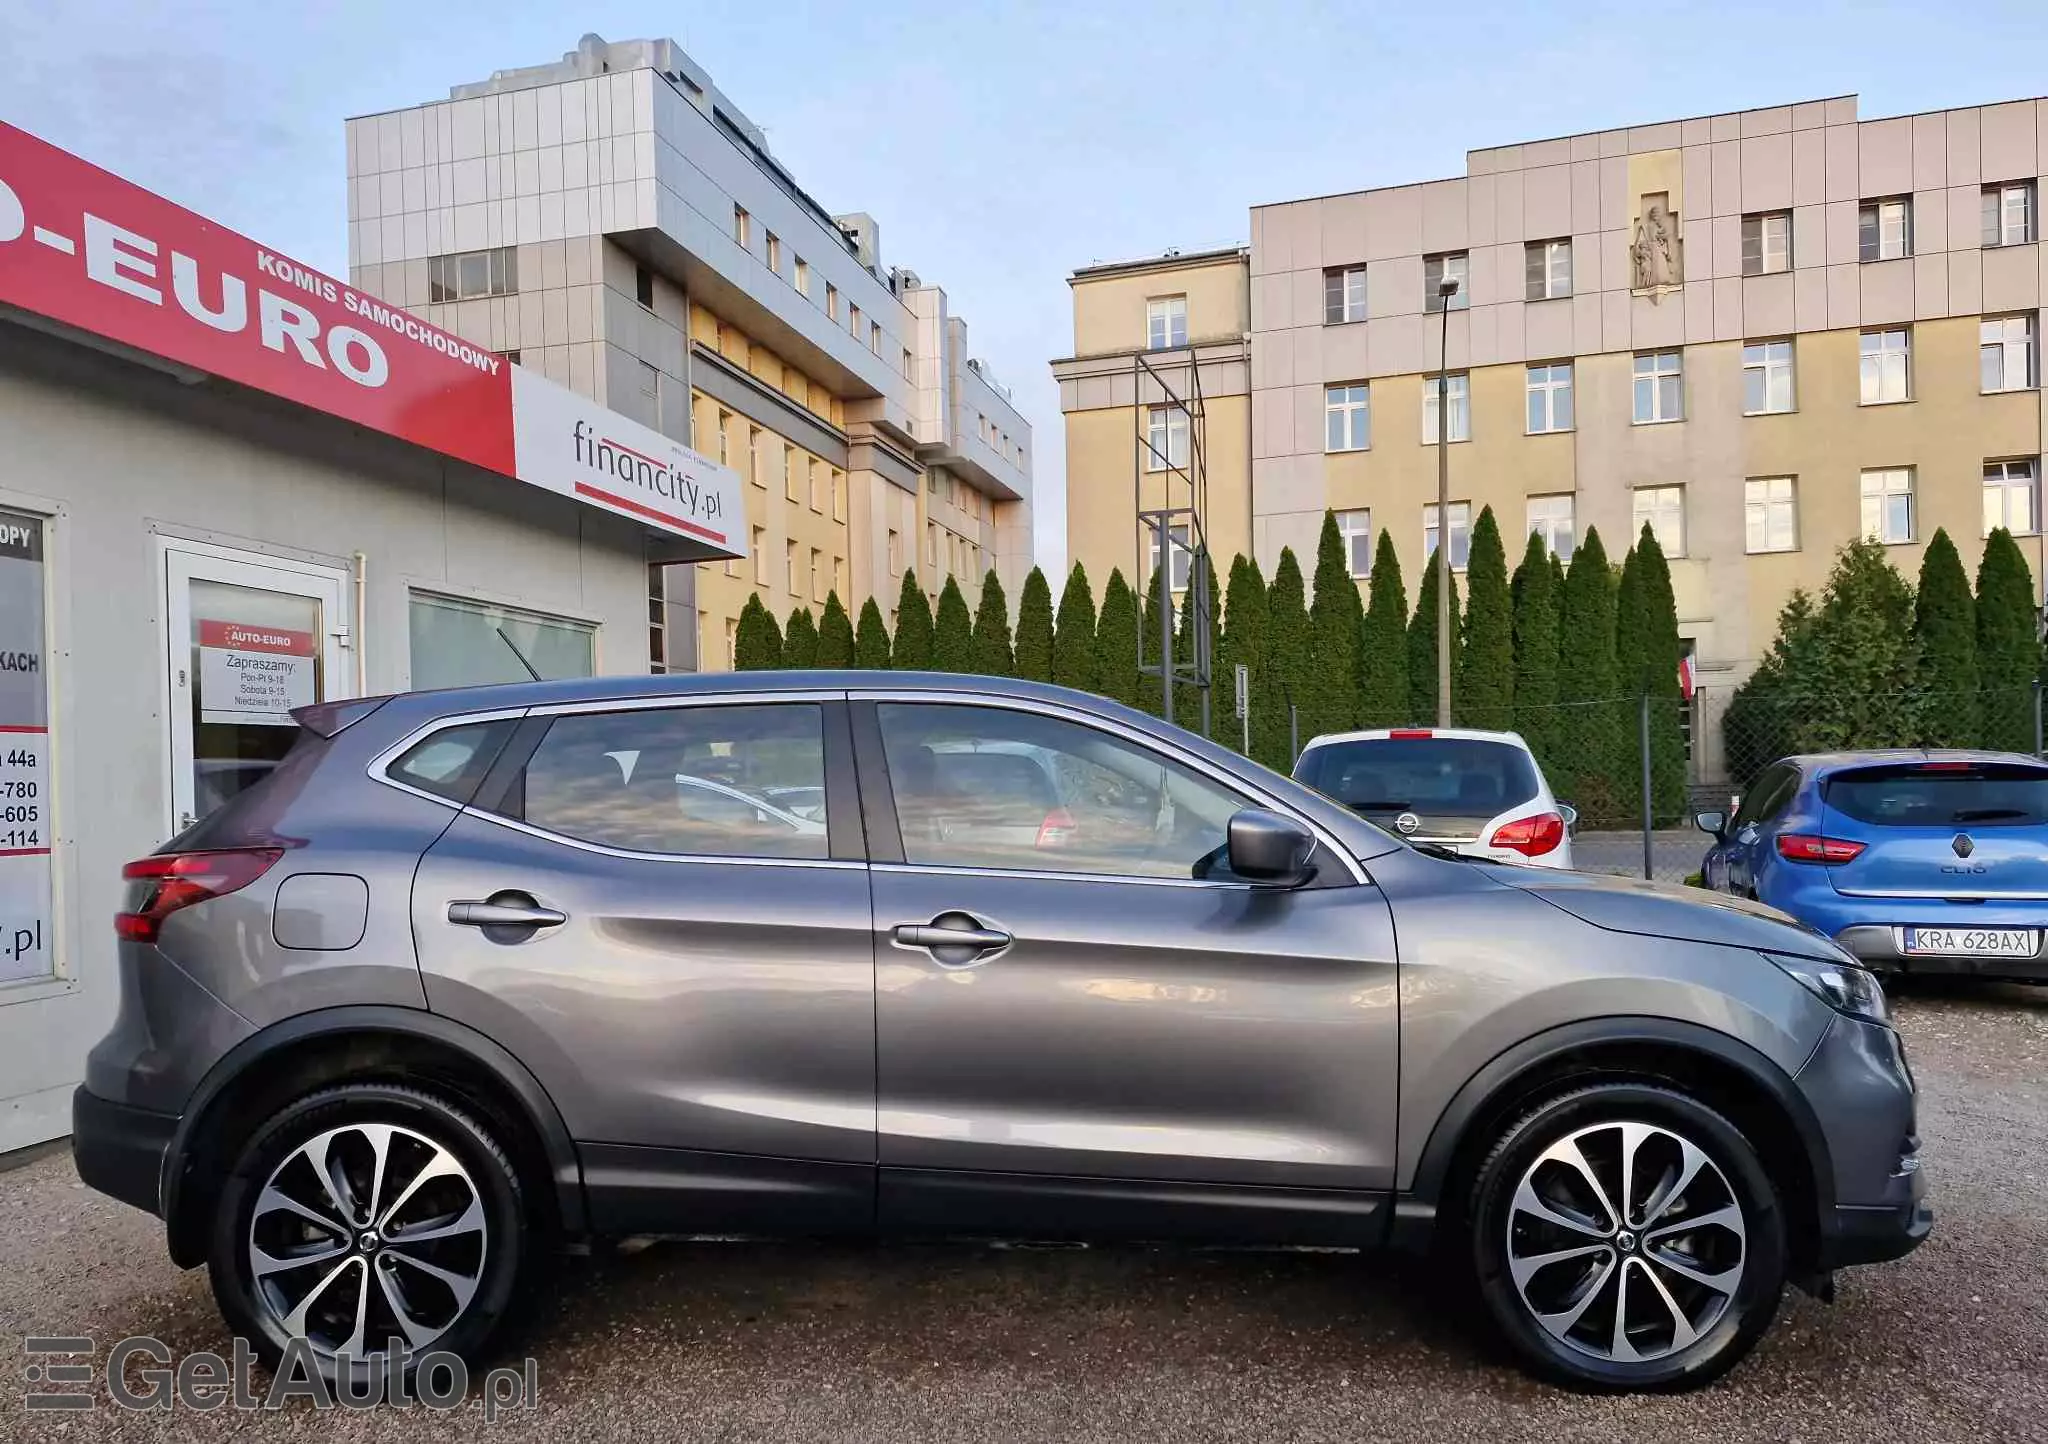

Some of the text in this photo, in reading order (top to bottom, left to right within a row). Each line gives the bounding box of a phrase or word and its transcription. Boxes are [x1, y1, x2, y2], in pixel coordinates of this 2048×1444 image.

[257, 250, 499, 376] KOMIS SAMOCHODOWY
[573, 420, 722, 520] financity.pl
[231, 631, 291, 647] AUTO-EURO
[226, 654, 296, 675] Zapraszamy:
[240, 684, 267, 695] Sobota
[8, 749, 36, 767] 44a
[0, 830, 38, 846] -114
[1940, 865, 1987, 874] CLIO
[0, 920, 41, 961] .pl
[1917, 931, 2026, 951] KRA 628AX
